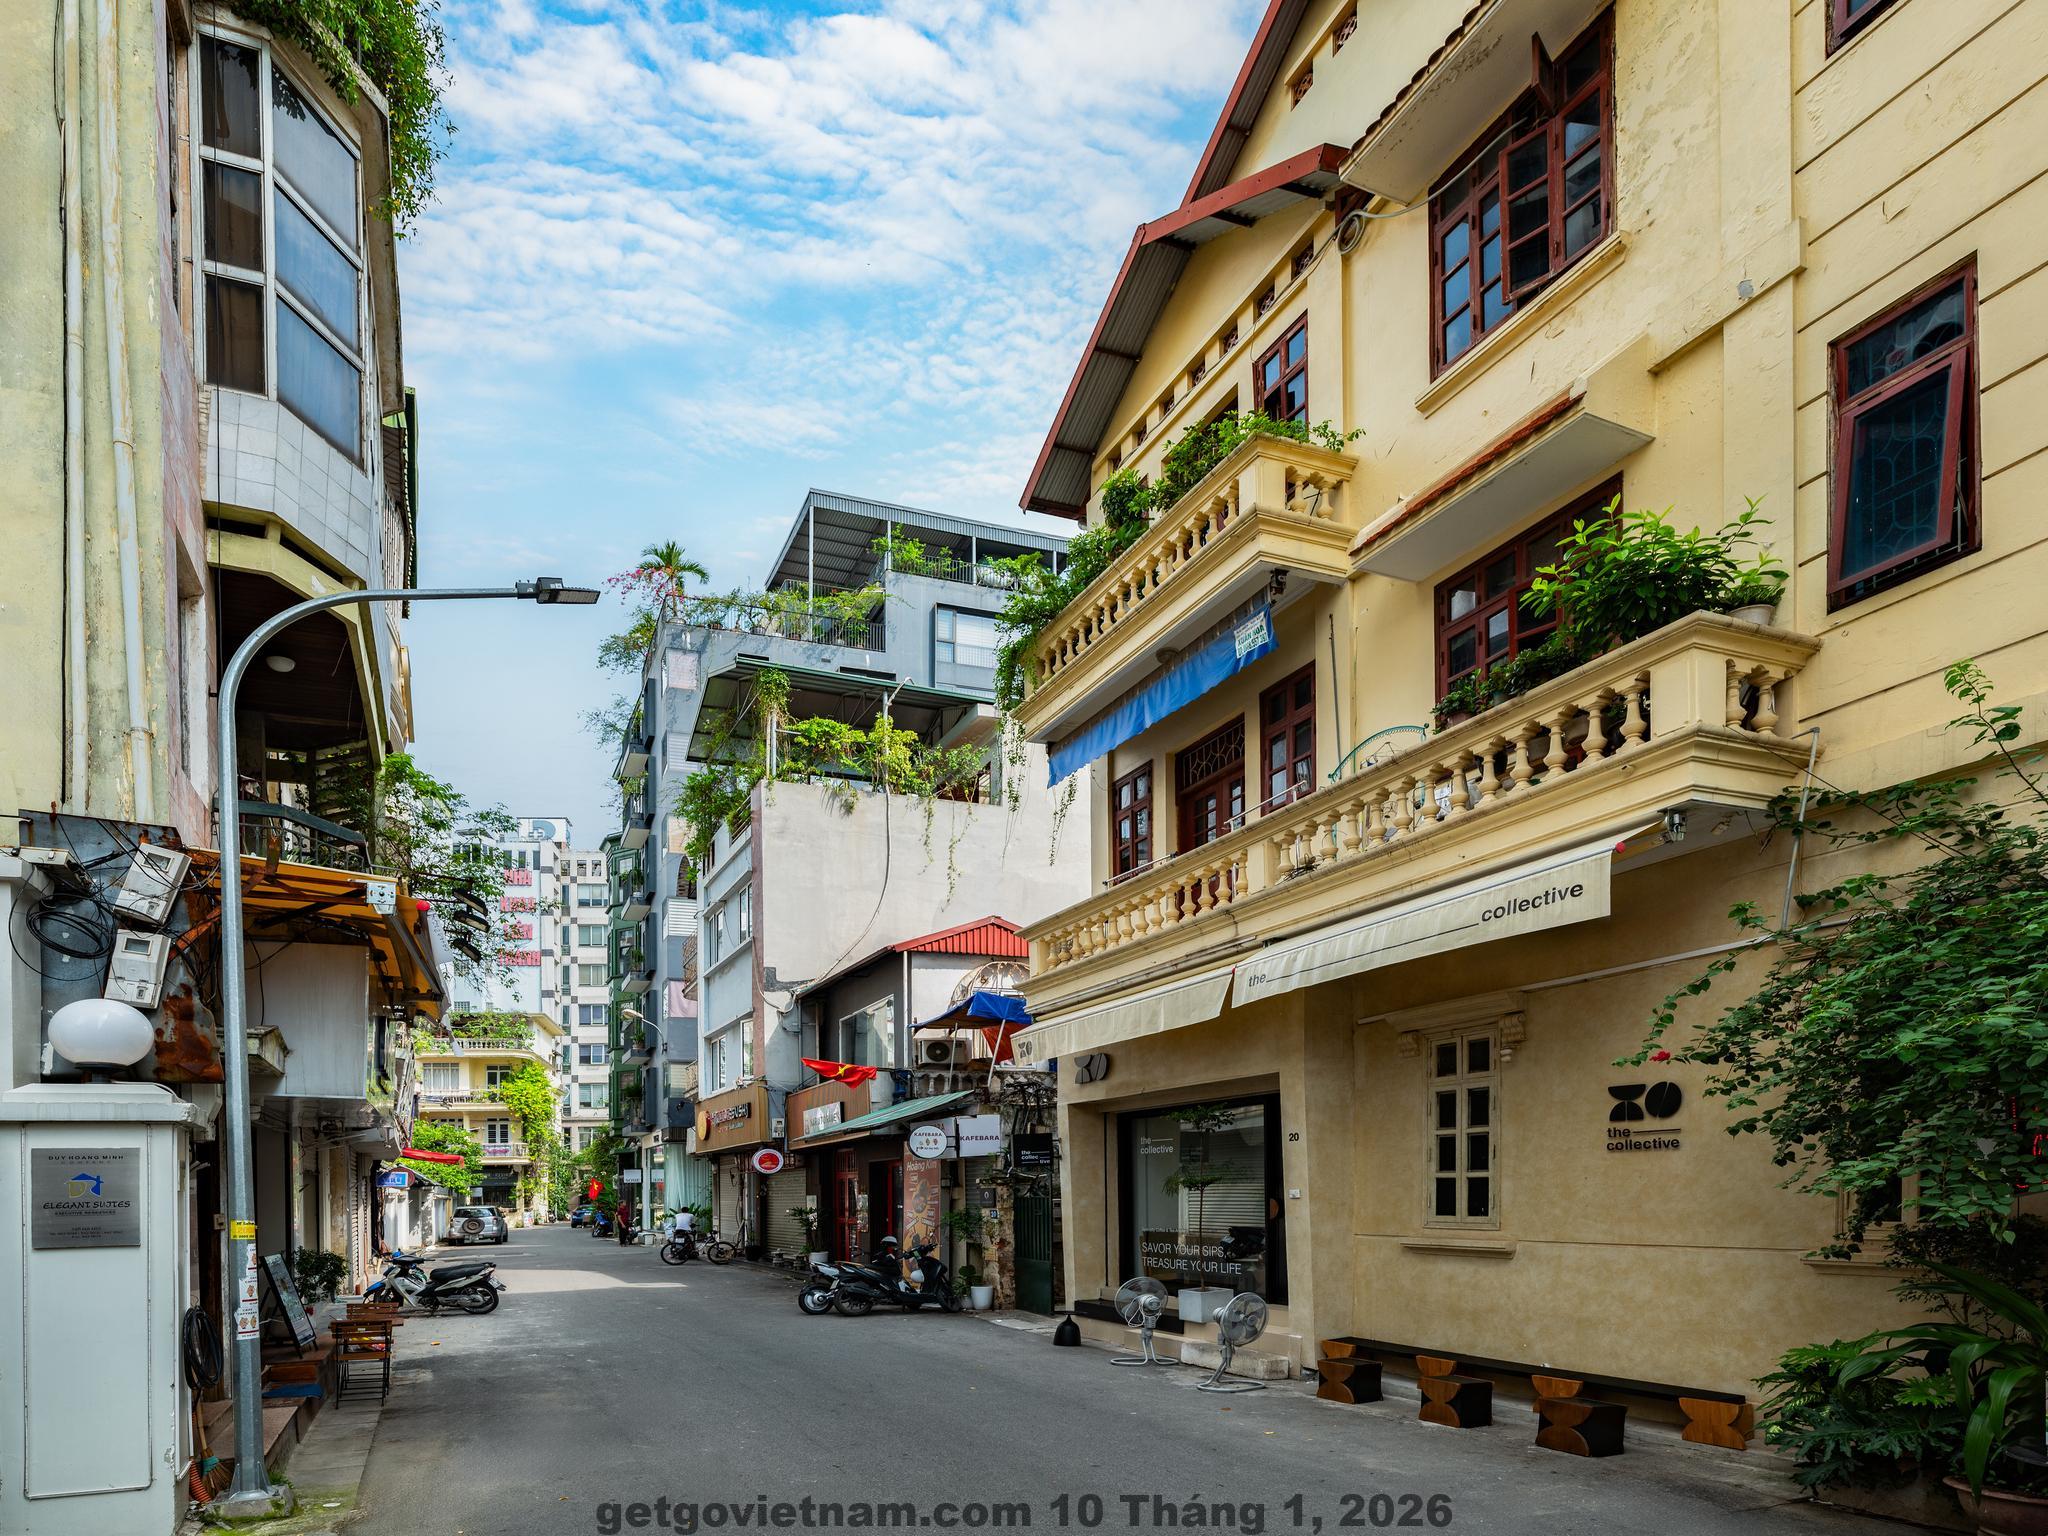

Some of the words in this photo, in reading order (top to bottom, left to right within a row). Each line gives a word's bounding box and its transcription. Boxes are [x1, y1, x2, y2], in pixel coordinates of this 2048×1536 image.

[1248, 972, 1267, 988] the
[1481, 883, 1584, 923] collective
[1289, 1132, 1300, 1142] 20
[1607, 1127, 1631, 1138] the
[1140, 1136, 1152, 1145] the
[1606, 1138, 1680, 1151] collective
[1140, 1145, 1174, 1154] collective
[43, 1201, 91, 1210] ELEGANT
[1141, 1242, 1172, 1255] SAVOR
[1173, 1244, 1201, 1256] YOUR
[1201, 1246, 1227, 1259] SIPS,
[1142, 1256, 1188, 1270] TREASURE
[1190, 1260, 1219, 1273] YOUR
[1220, 1263, 1242, 1275] LIFE
